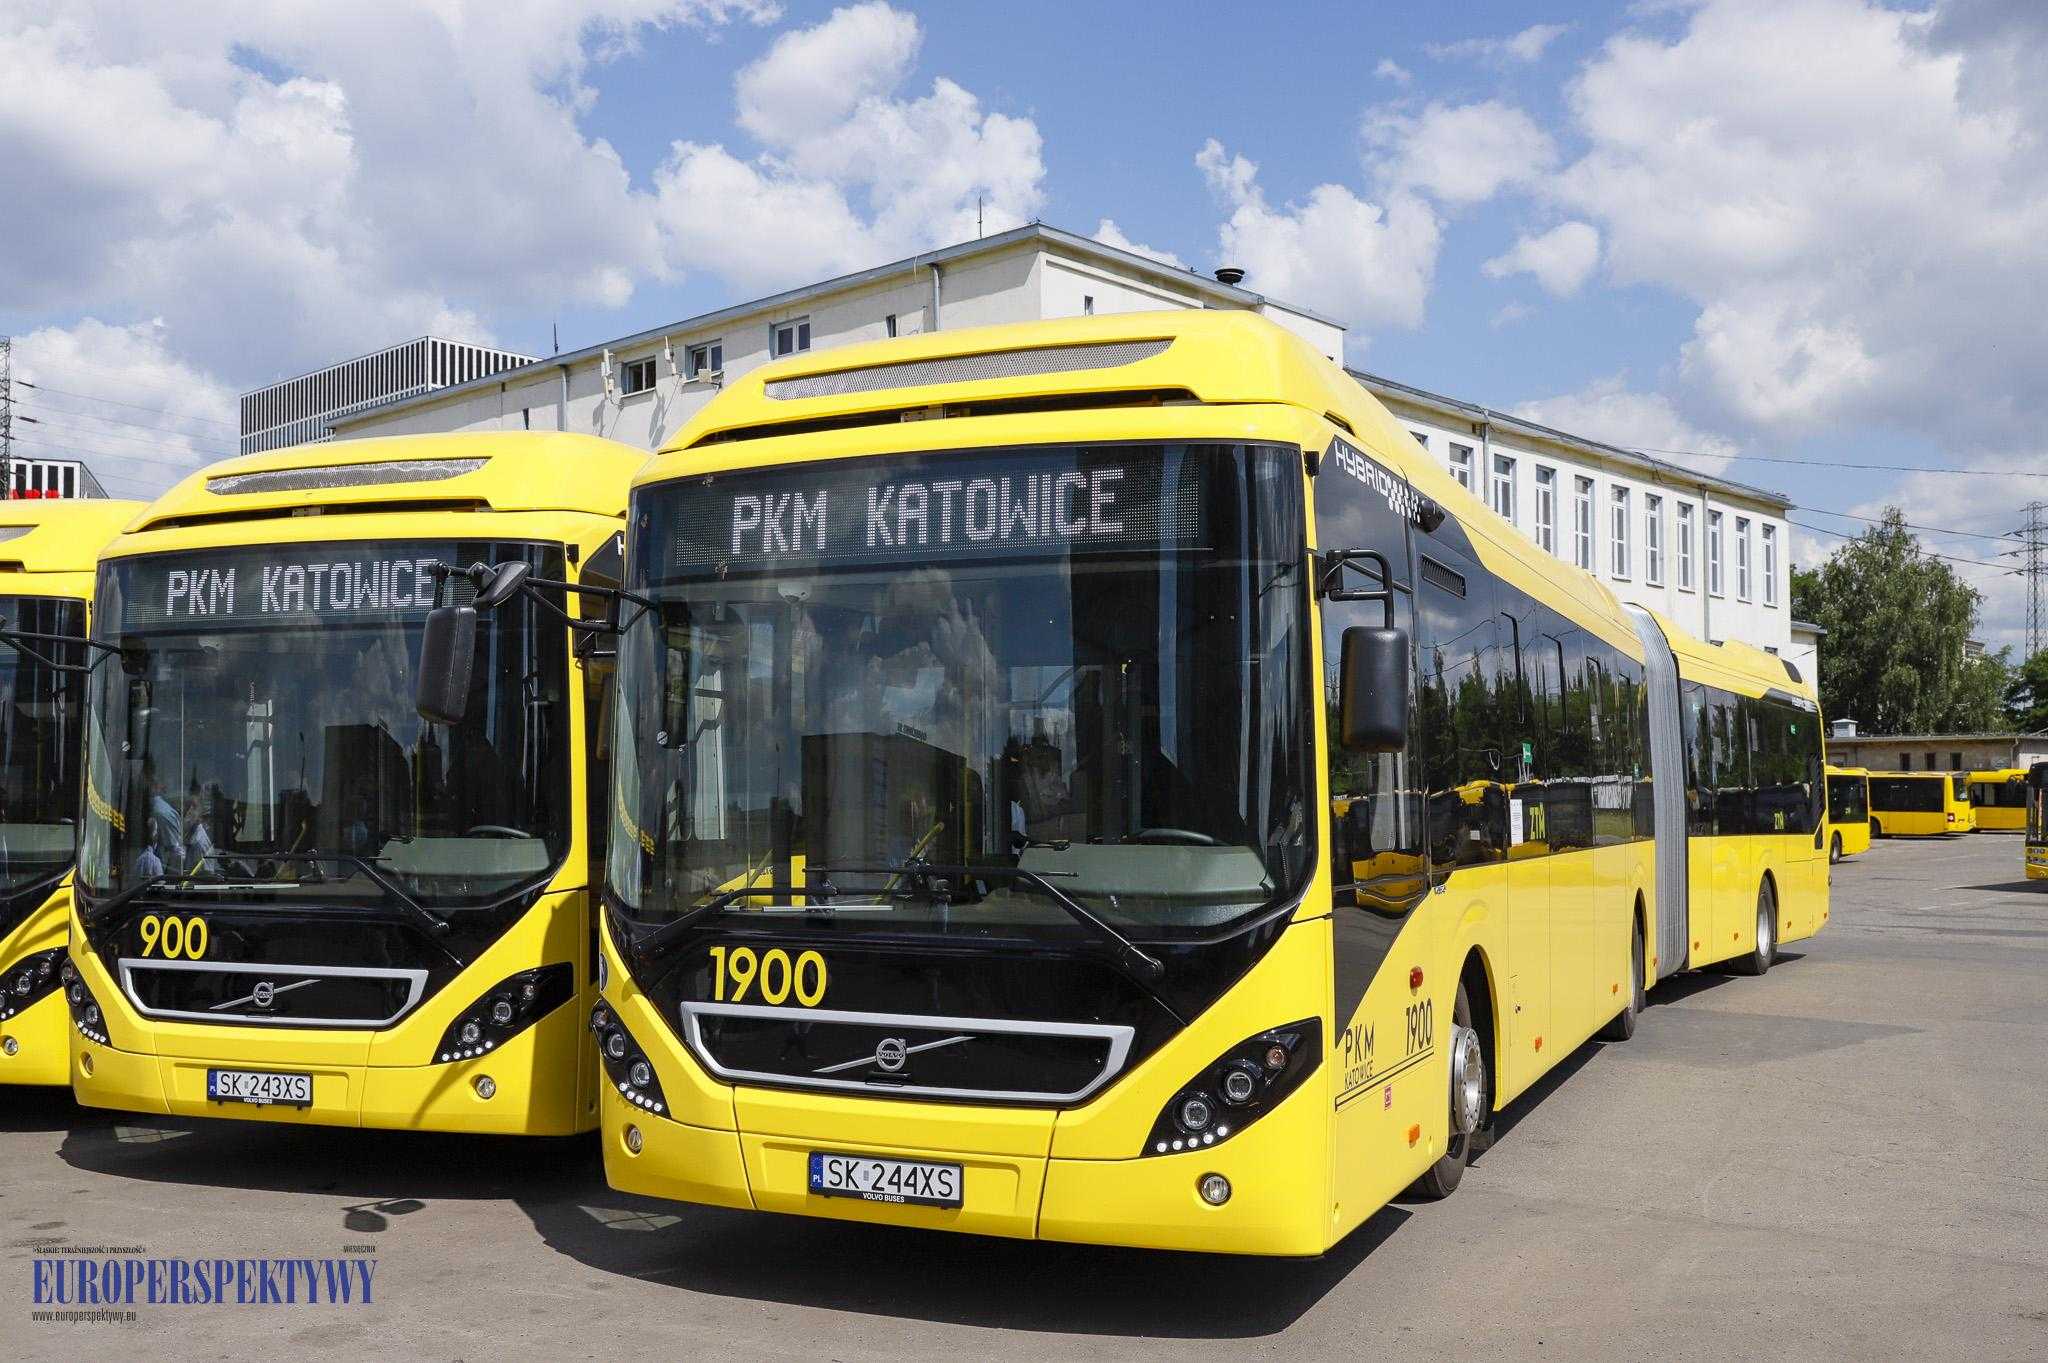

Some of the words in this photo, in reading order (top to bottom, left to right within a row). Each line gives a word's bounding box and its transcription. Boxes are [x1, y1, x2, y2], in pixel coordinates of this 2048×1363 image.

[1335, 440, 1389, 498] HYBRID
[732, 490, 828, 554] PKM
[867, 468, 1124, 547] KATOWICE
[166, 568, 235, 615] PKM
[261, 559, 438, 612] KATOWICE
[1529, 802, 1546, 840] ZTM
[140, 915, 208, 960] 900
[709, 946, 827, 1007] 1900
[1345, 1018, 1375, 1068] PKM
[1405, 998, 1433, 1056] 1900
[220, 1073, 242, 1096] SK
[249, 1075, 306, 1099] 243XS
[1344, 1060, 1374, 1090] KATOWICE
[813, 1174, 822, 1183] PL
[828, 1159, 860, 1189] SK
[871, 1163, 953, 1198] 244XS
[863, 1192, 883, 1201] VOLVO
[884, 1194, 905, 1203] BUSES
